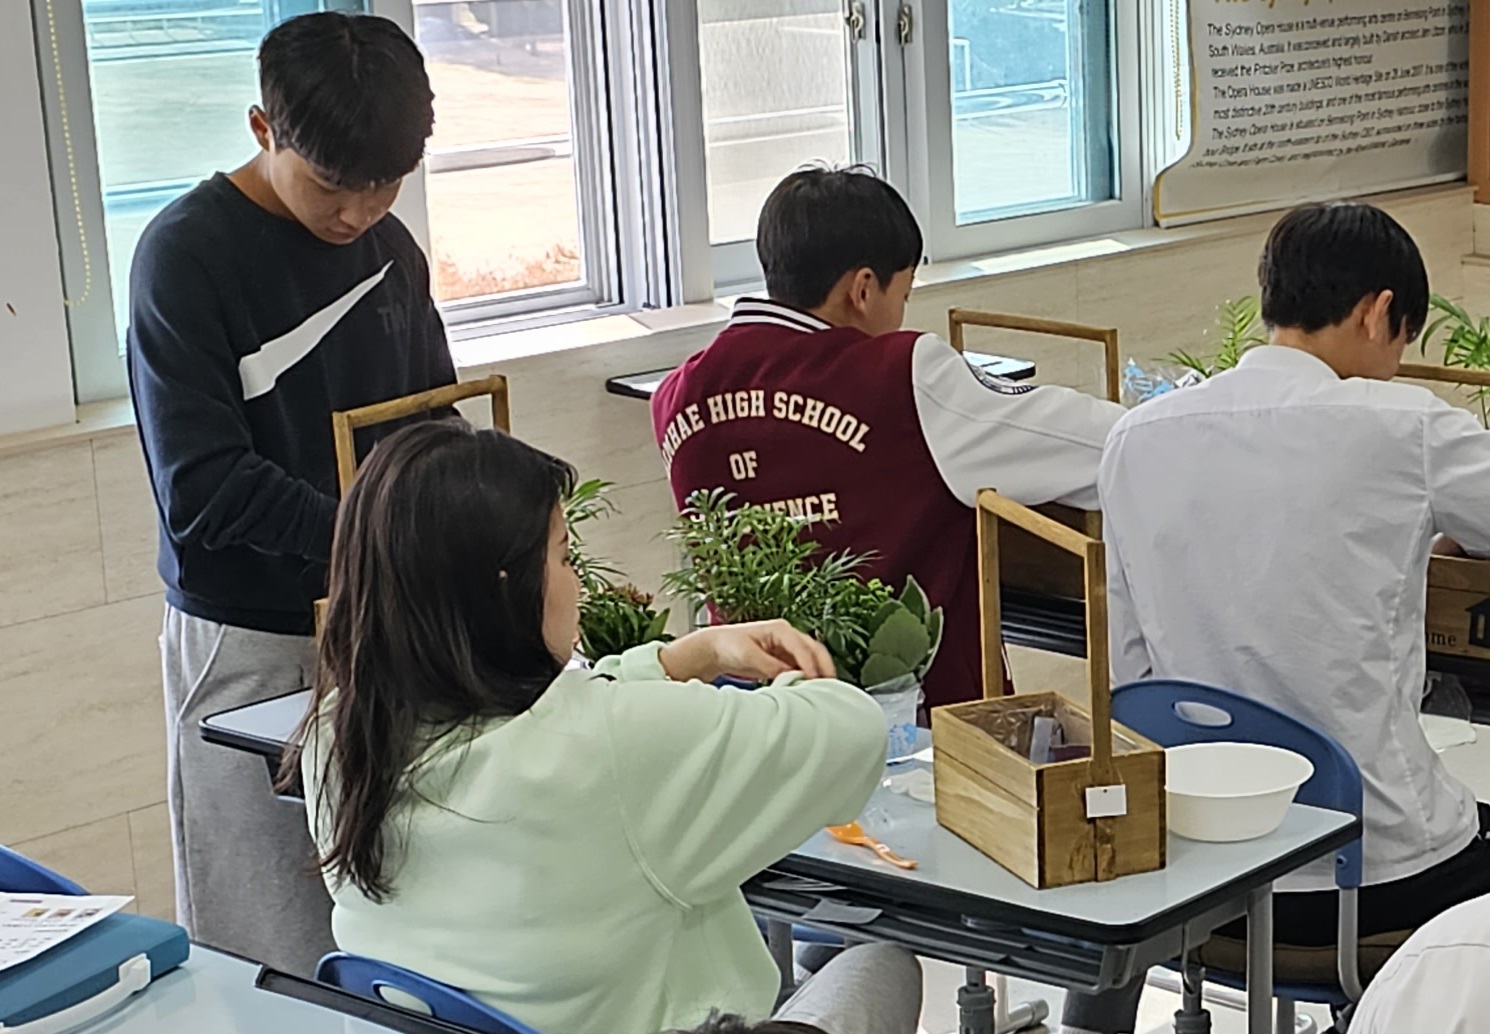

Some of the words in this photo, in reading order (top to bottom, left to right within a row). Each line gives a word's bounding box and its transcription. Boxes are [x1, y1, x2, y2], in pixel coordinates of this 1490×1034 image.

[1208, 23, 1223, 37] The
[1224, 22, 1254, 37] Sydney
[1256, 21, 1275, 35] Opera
[1209, 44, 1229, 57] South
[1213, 86, 1226, 100] The
[1228, 84, 1248, 100] Opera
[707, 389, 766, 424] HIGH
[773, 391, 871, 452] SCHOOL
[729, 450, 758, 480] OF
